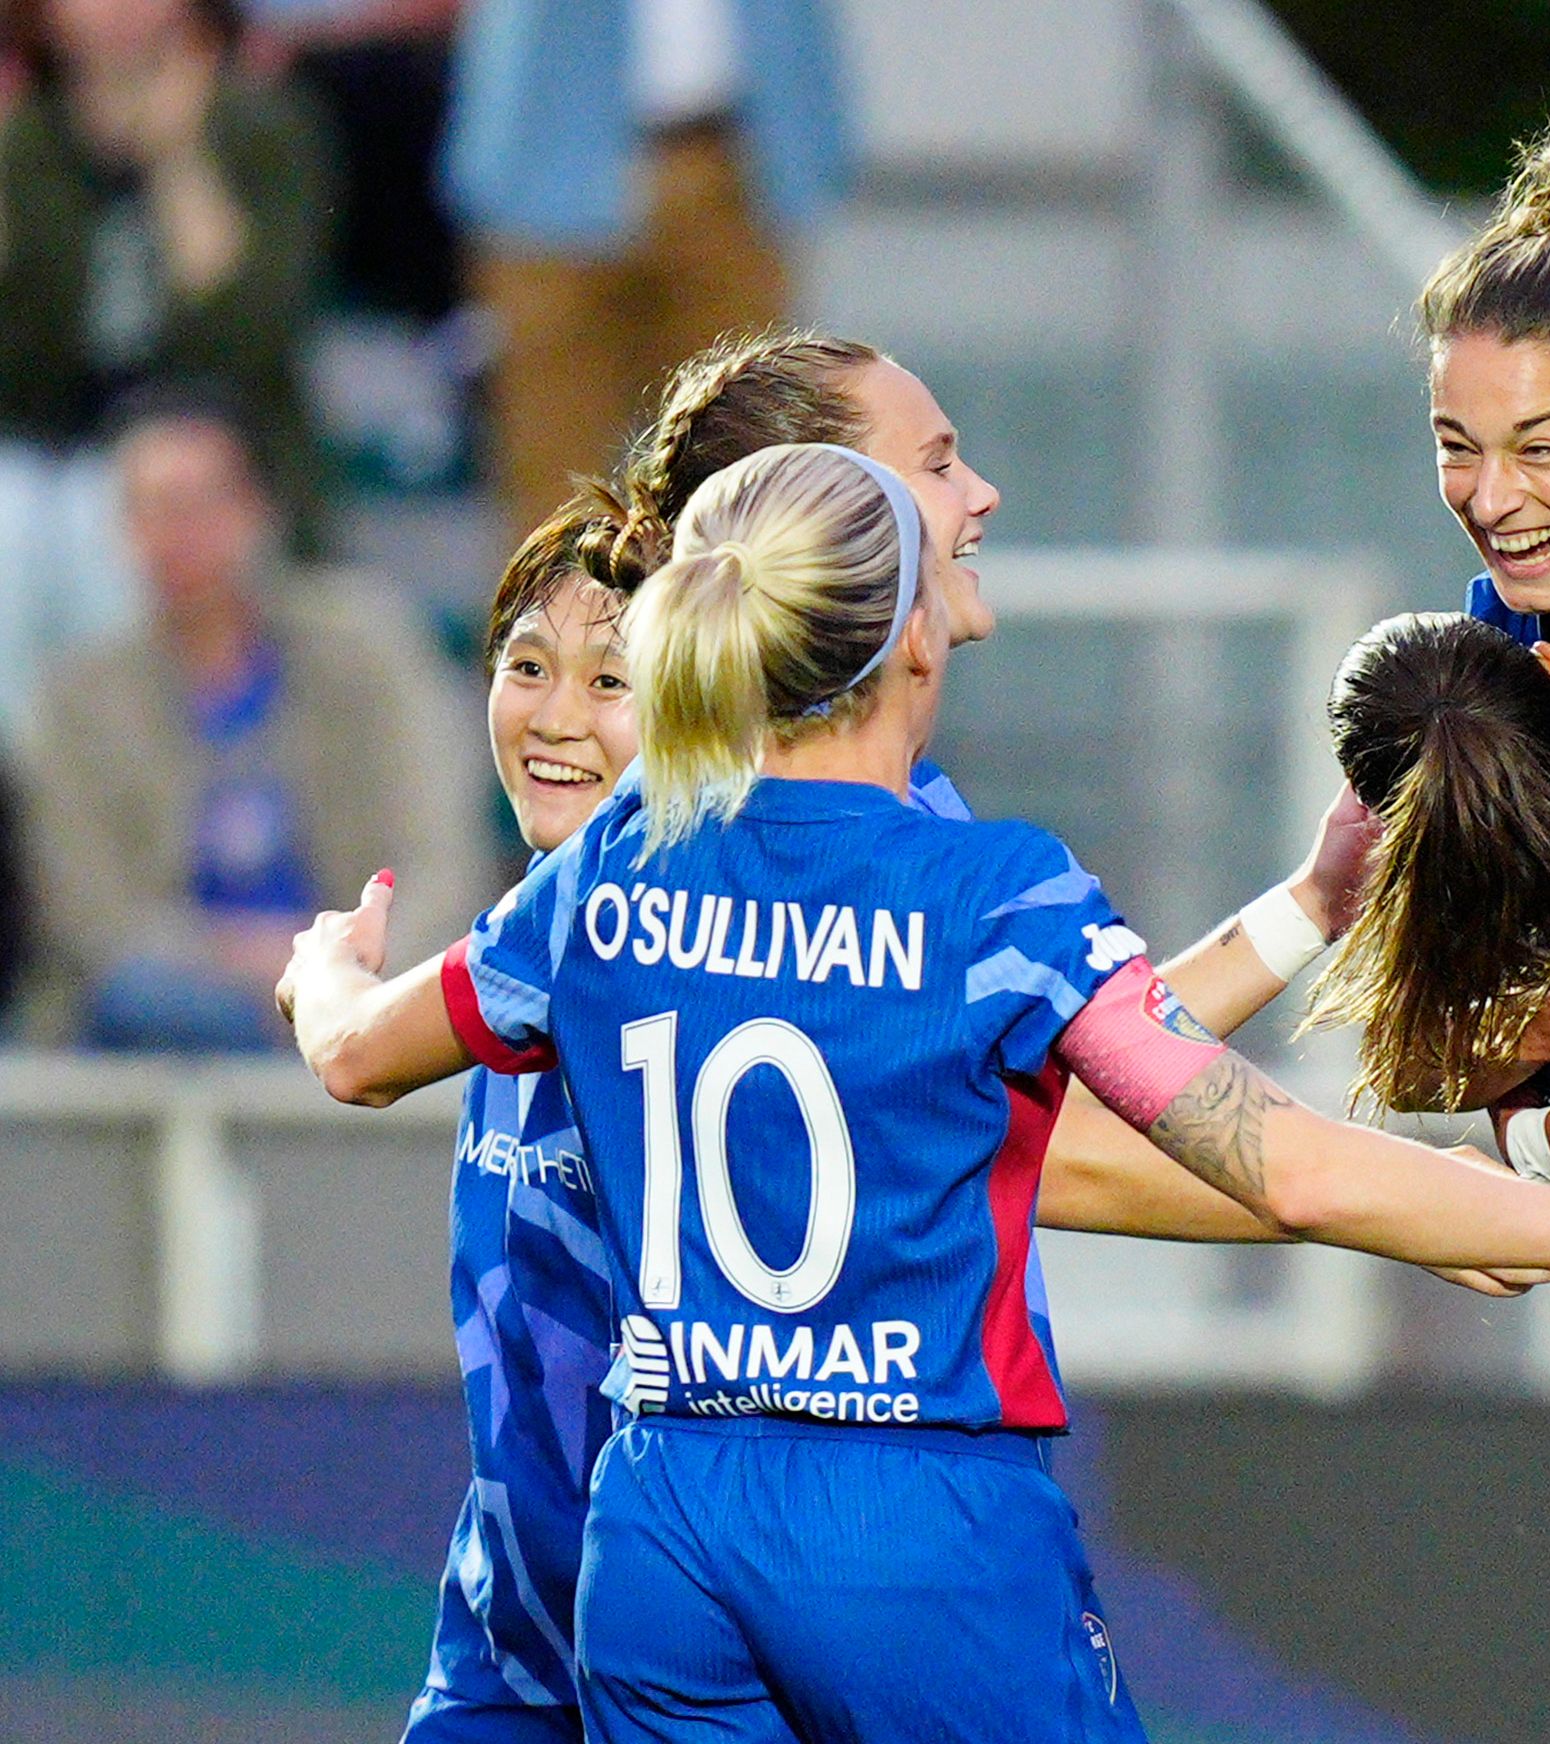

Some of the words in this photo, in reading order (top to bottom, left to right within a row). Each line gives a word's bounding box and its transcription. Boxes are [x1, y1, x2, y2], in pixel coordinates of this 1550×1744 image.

[585, 882, 925, 990] O'SULLIVAN
[620, 1010, 857, 1314] 10
[670, 1320, 921, 1384] INMAR
[684, 1383, 920, 1424] intelligence
